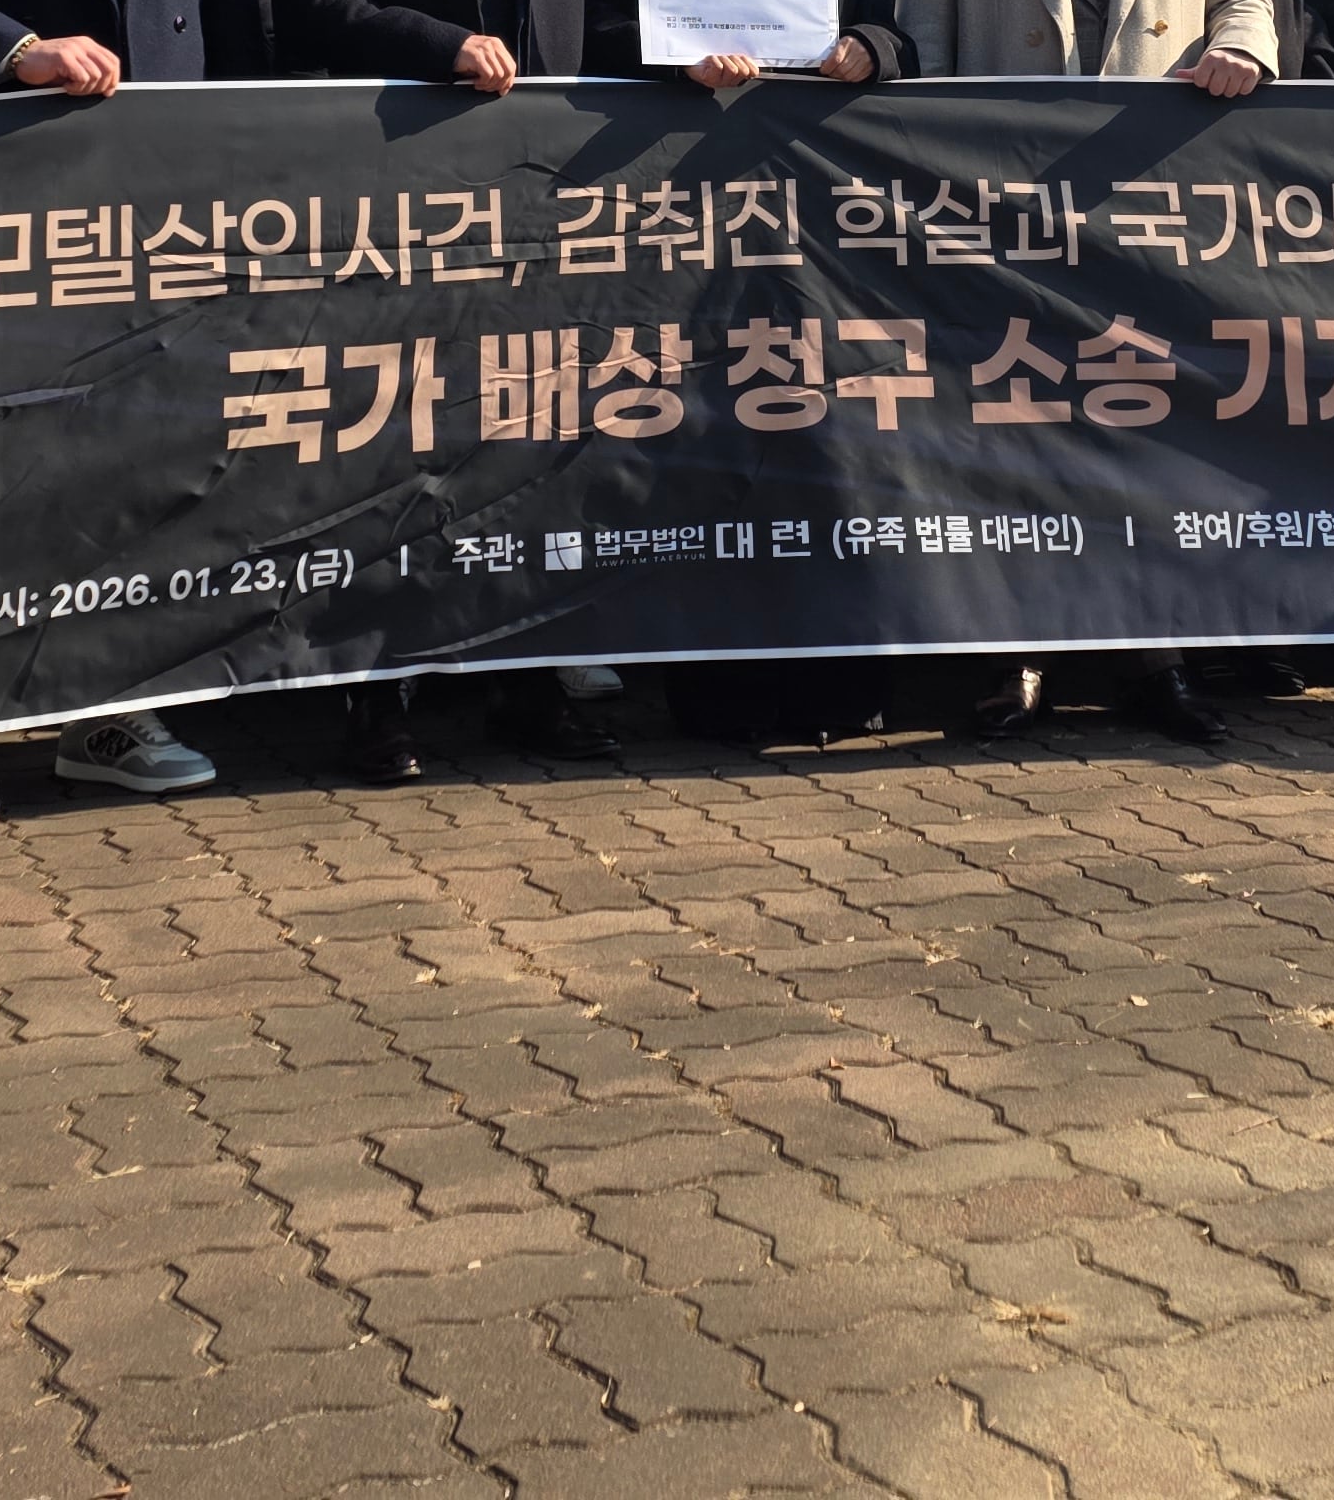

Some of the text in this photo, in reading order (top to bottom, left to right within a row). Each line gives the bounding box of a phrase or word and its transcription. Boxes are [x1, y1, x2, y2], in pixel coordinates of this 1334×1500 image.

[557, 179, 803, 274] 감춰진
[832, 177, 1087, 265] 학살과
[224, 337, 445, 463] 국가
[481, 324, 692, 441] 배상
[728, 318, 934, 430] 청구
[972, 315, 1177, 428] 소송
[50, 574, 157, 618] 2026.
[170, 567, 219, 600] 01.
[231, 559, 286, 594] 23.
[297, 549, 354, 593] (금)
[453, 534, 524, 574] 주관:
[595, 526, 704, 556] 법무법인
[833, 517, 906, 559] (유족
[915, 516, 973, 552] 법률
[981, 514, 1083, 555] 대리인)
